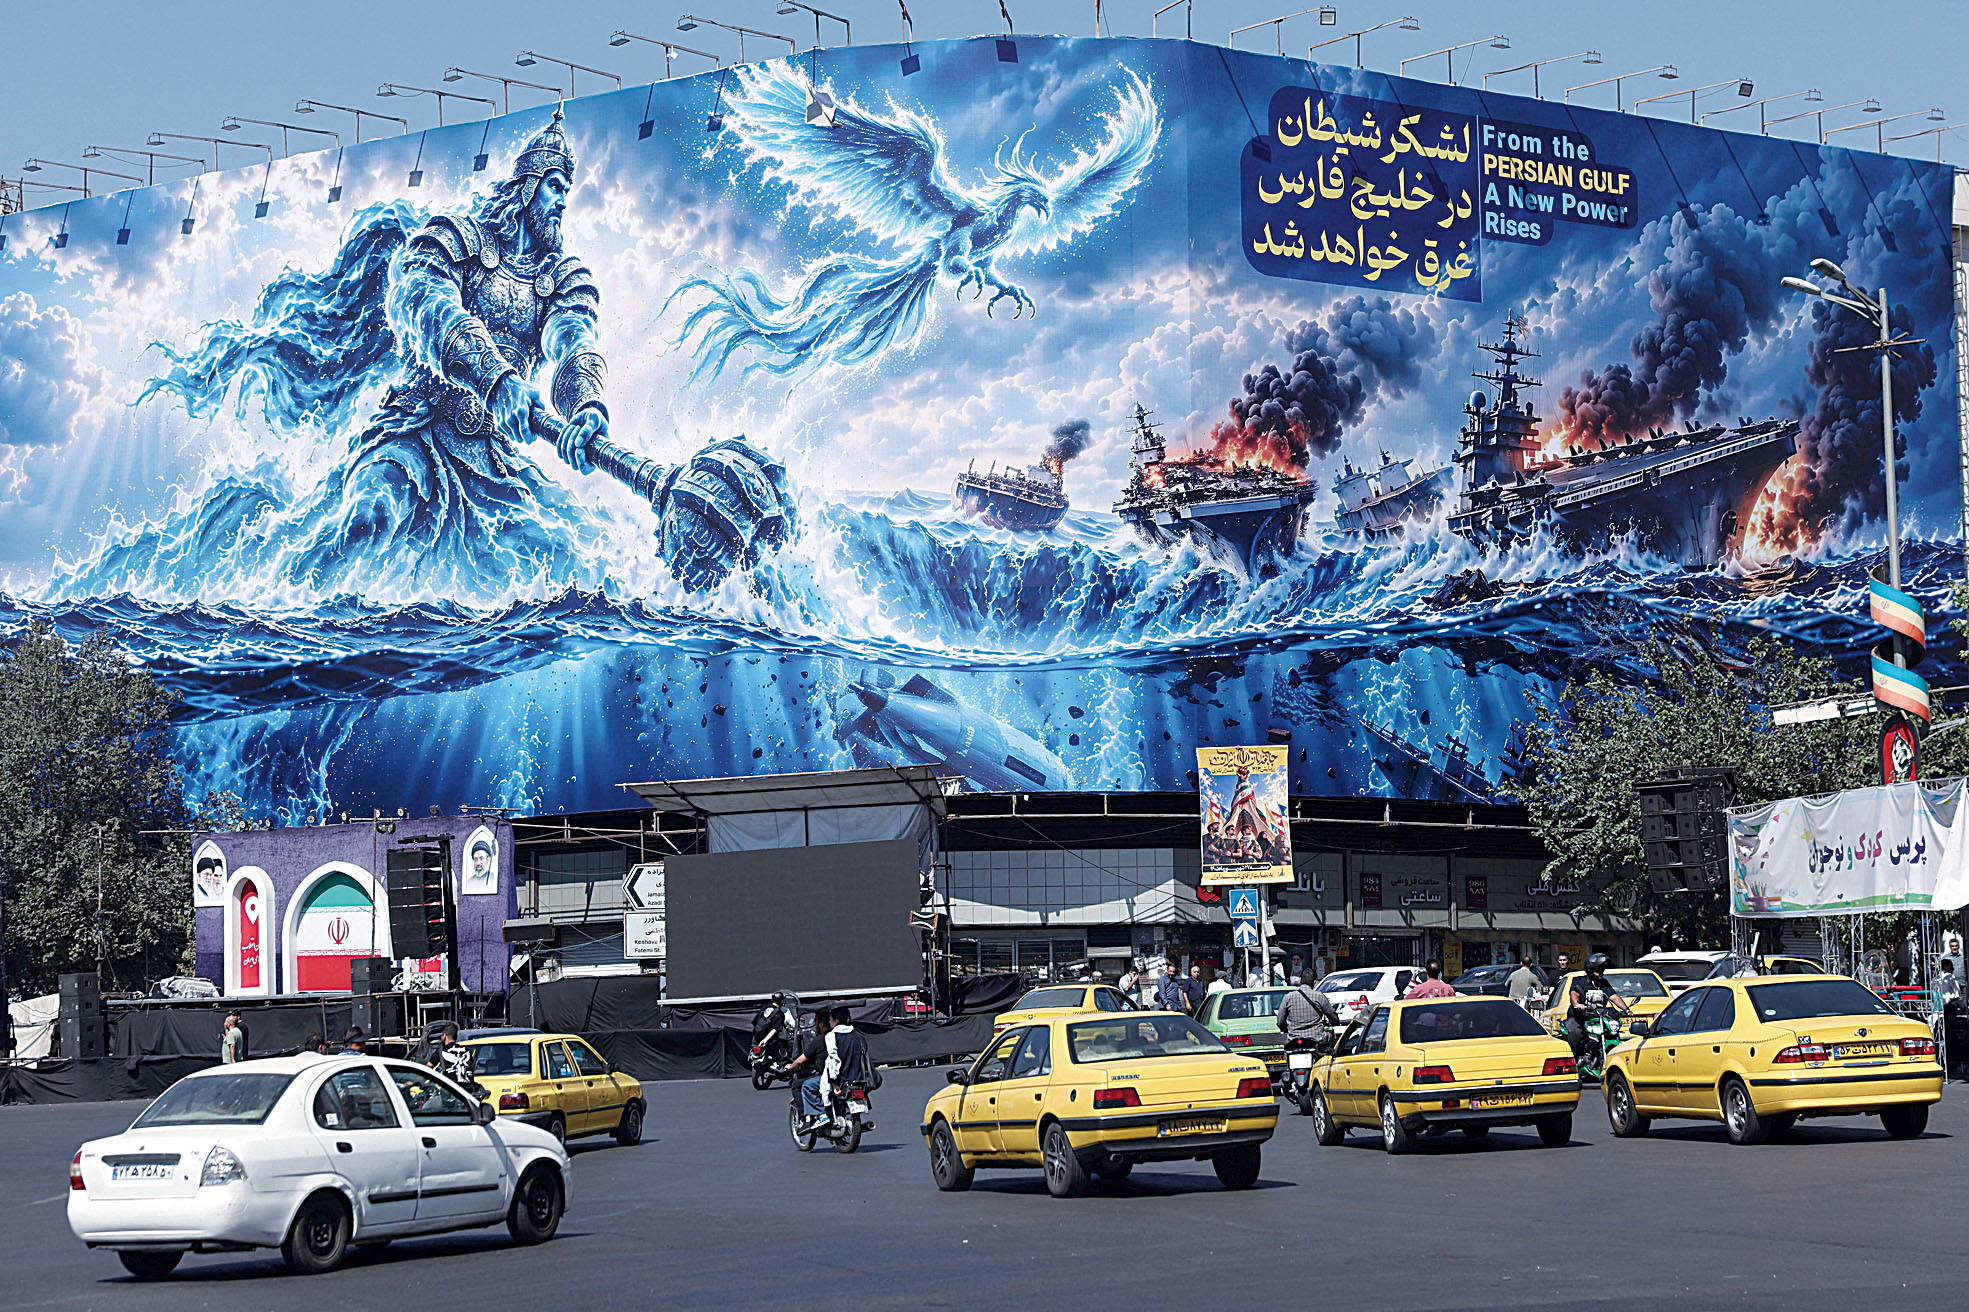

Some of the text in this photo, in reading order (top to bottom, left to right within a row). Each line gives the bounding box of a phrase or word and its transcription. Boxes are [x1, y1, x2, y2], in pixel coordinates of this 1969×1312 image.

[1276, 97, 1470, 164] لشکر شیطان
[1483, 125, 1590, 161] From the
[1258, 154, 1473, 229] در خلیج فارس
[1483, 154, 1631, 195] PERSIAN GULF
[1484, 182, 1629, 224] A New Power
[1486, 211, 1542, 240] Rises
[1253, 220, 1473, 291] غرق خواهد شد
[1808, 835, 1844, 873] نوجوان
[1847, 846, 1853, 870] و
[1401, 889, 1441, 906] ساعتی
[1528, 877, 1580, 896] کفش ملی
[645, 928, 664, 936] اطمی
